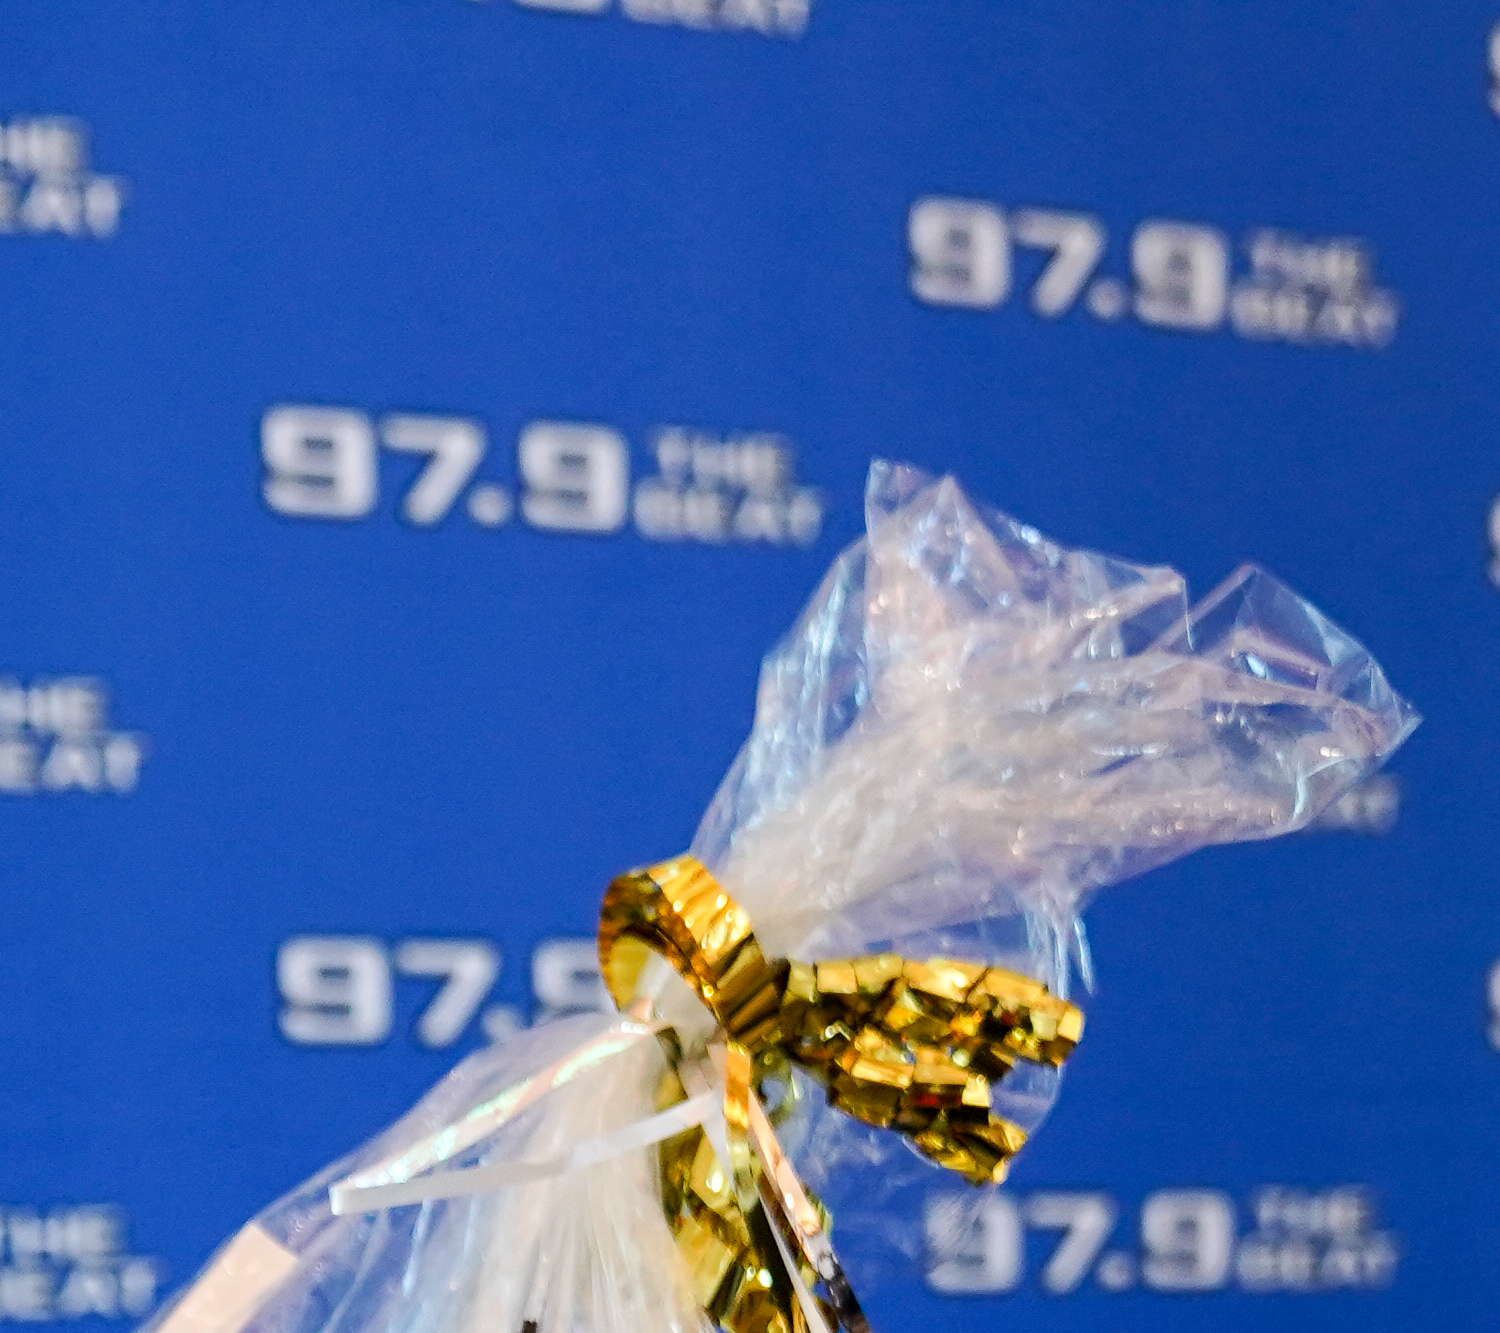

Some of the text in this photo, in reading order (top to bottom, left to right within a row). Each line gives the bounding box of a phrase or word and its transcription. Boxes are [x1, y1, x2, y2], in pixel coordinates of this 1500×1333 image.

[908, 197, 1231, 332] 97.9
[261, 404, 631, 534] 97.9
[650, 423, 795, 492] THE
[634, 475, 822, 546] BEAT
[925, 1189, 1235, 1294] 97.9
